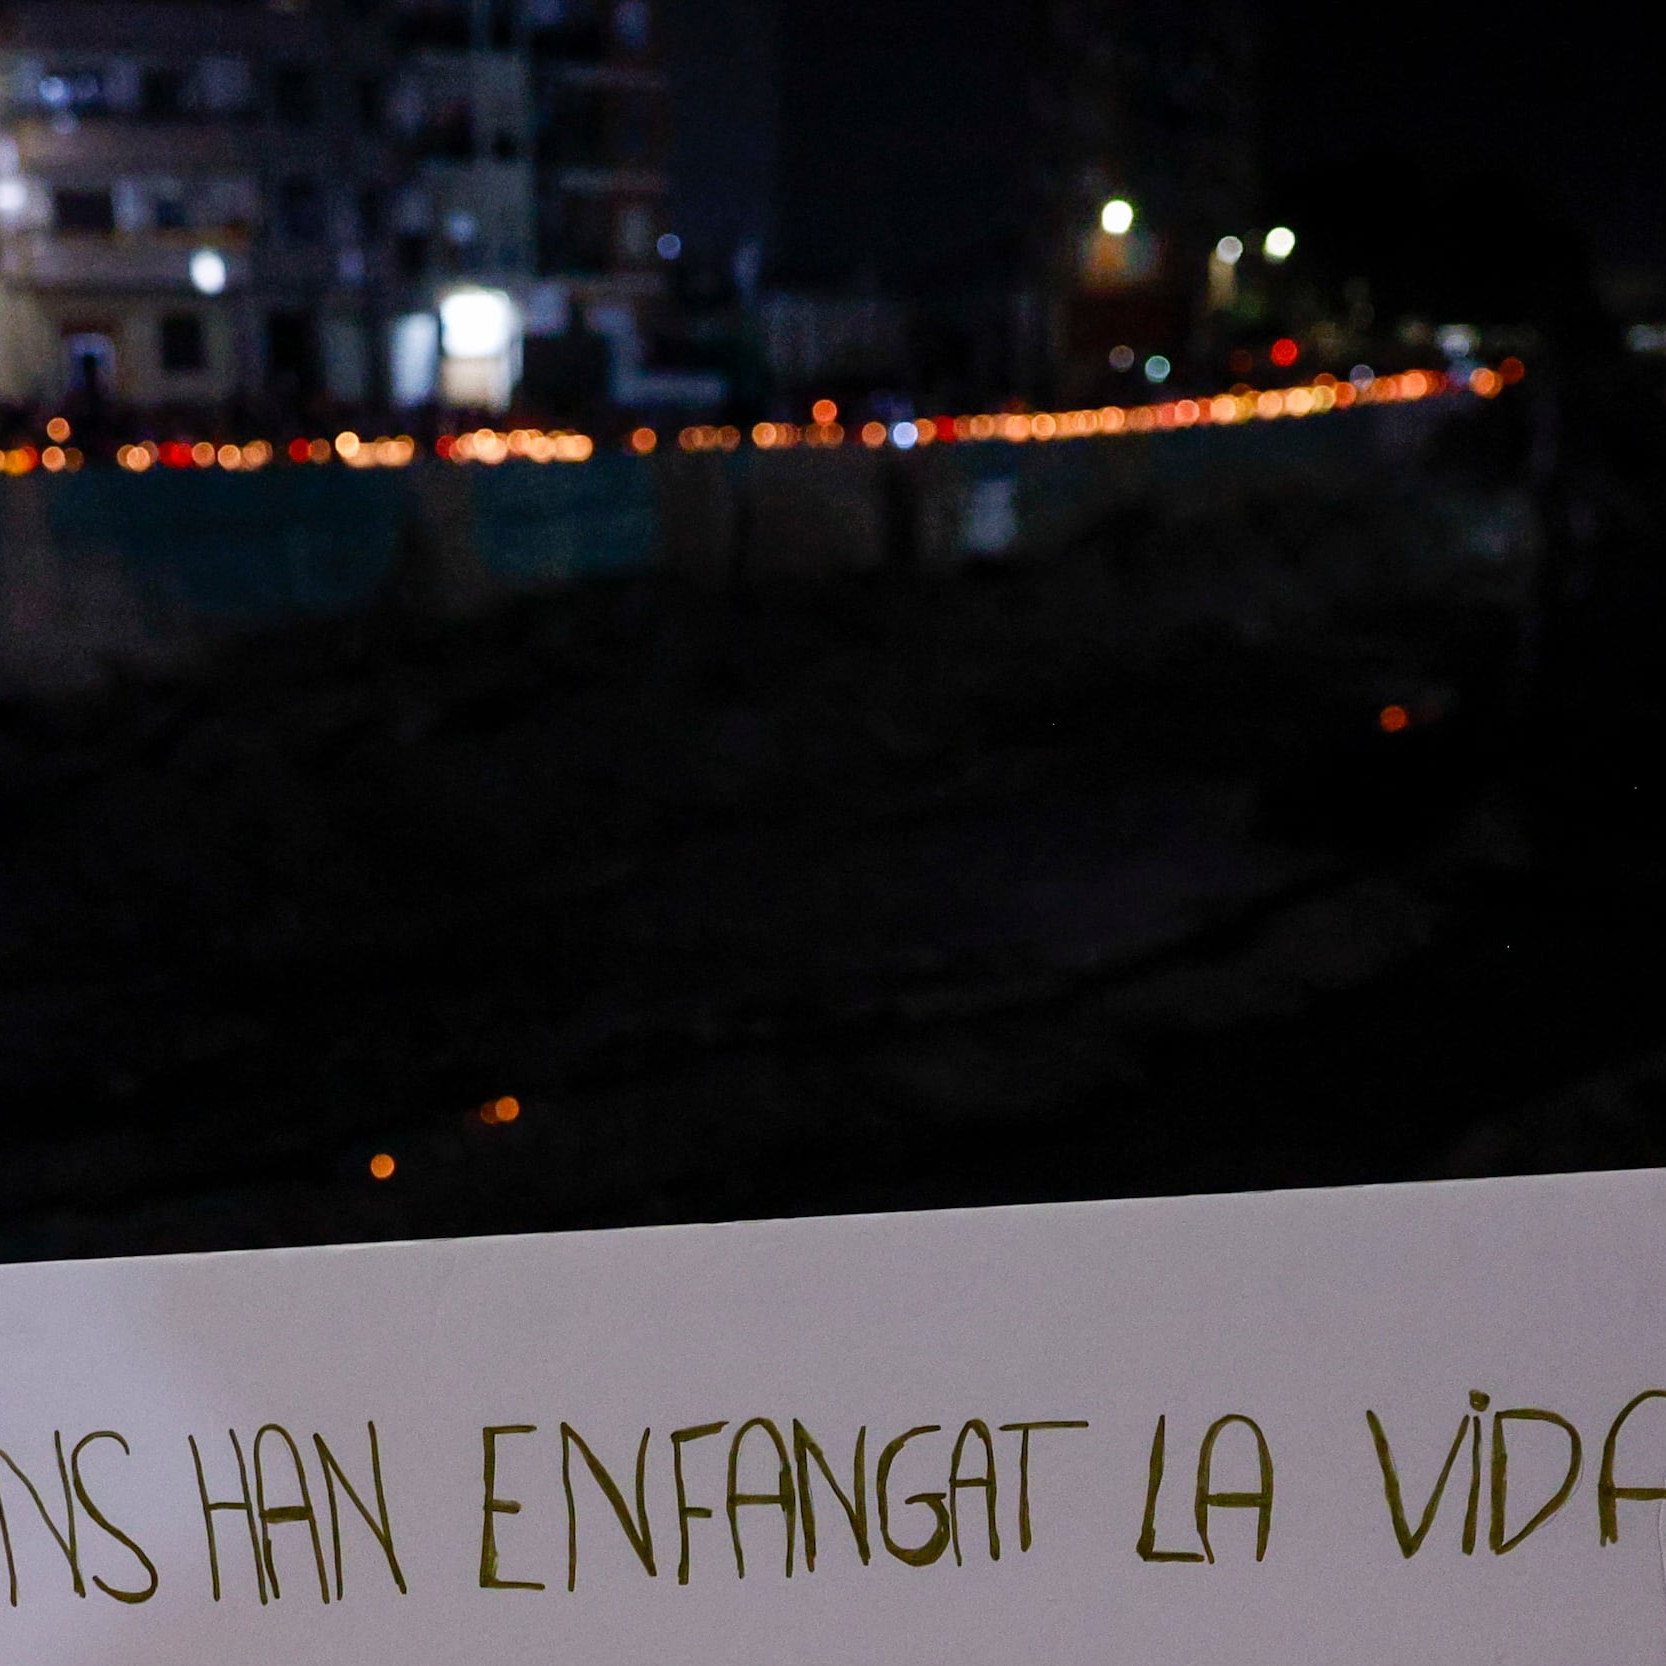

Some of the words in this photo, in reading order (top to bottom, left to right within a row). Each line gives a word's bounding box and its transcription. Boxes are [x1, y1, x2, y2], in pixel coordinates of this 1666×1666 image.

[188, 1420, 407, 1606] HAN
[479, 1417, 1089, 1592] ENFANGAT
[1136, 1414, 1274, 1564] LA
